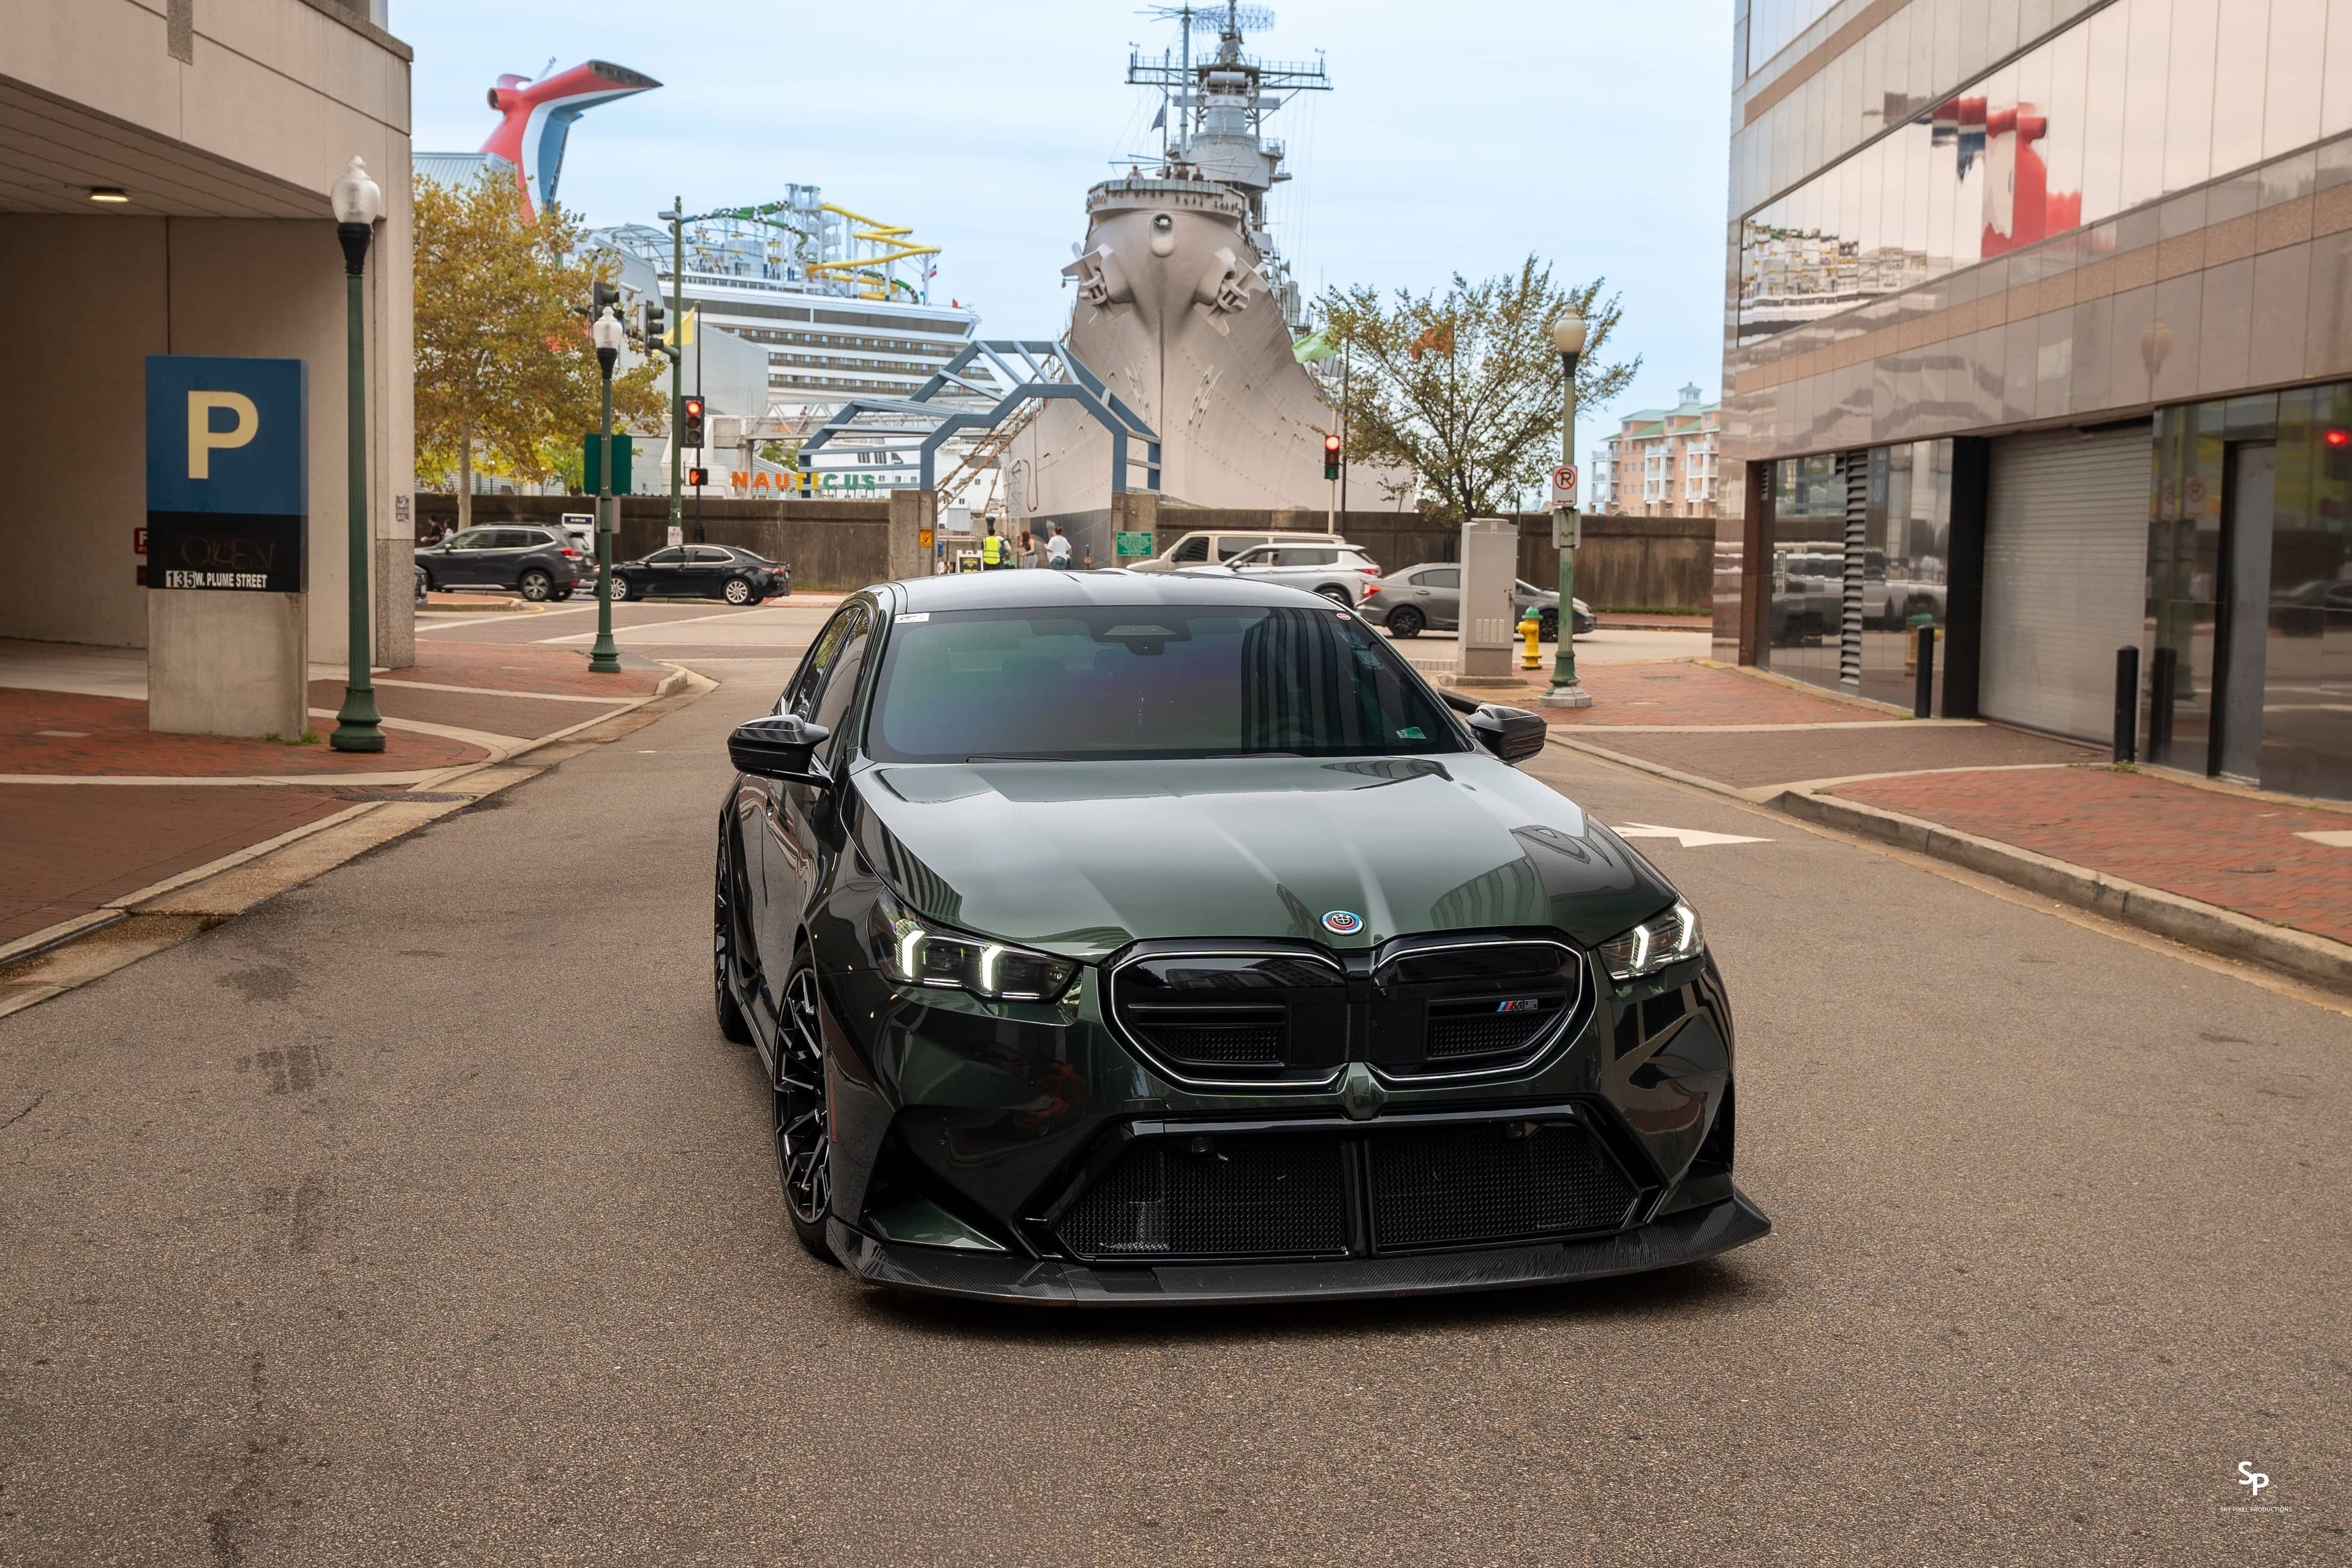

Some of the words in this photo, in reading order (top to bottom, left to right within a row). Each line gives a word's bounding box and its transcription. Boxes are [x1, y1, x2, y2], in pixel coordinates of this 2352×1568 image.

[188, 390, 258, 479] P
[731, 470, 876, 491] NAUTICUS
[167, 571, 195, 587] 135
[195, 572, 205, 586] W.
[206, 573, 234, 587] PLUME
[236, 574, 267, 588] STREET
[1510, 999, 1538, 1011] M5
